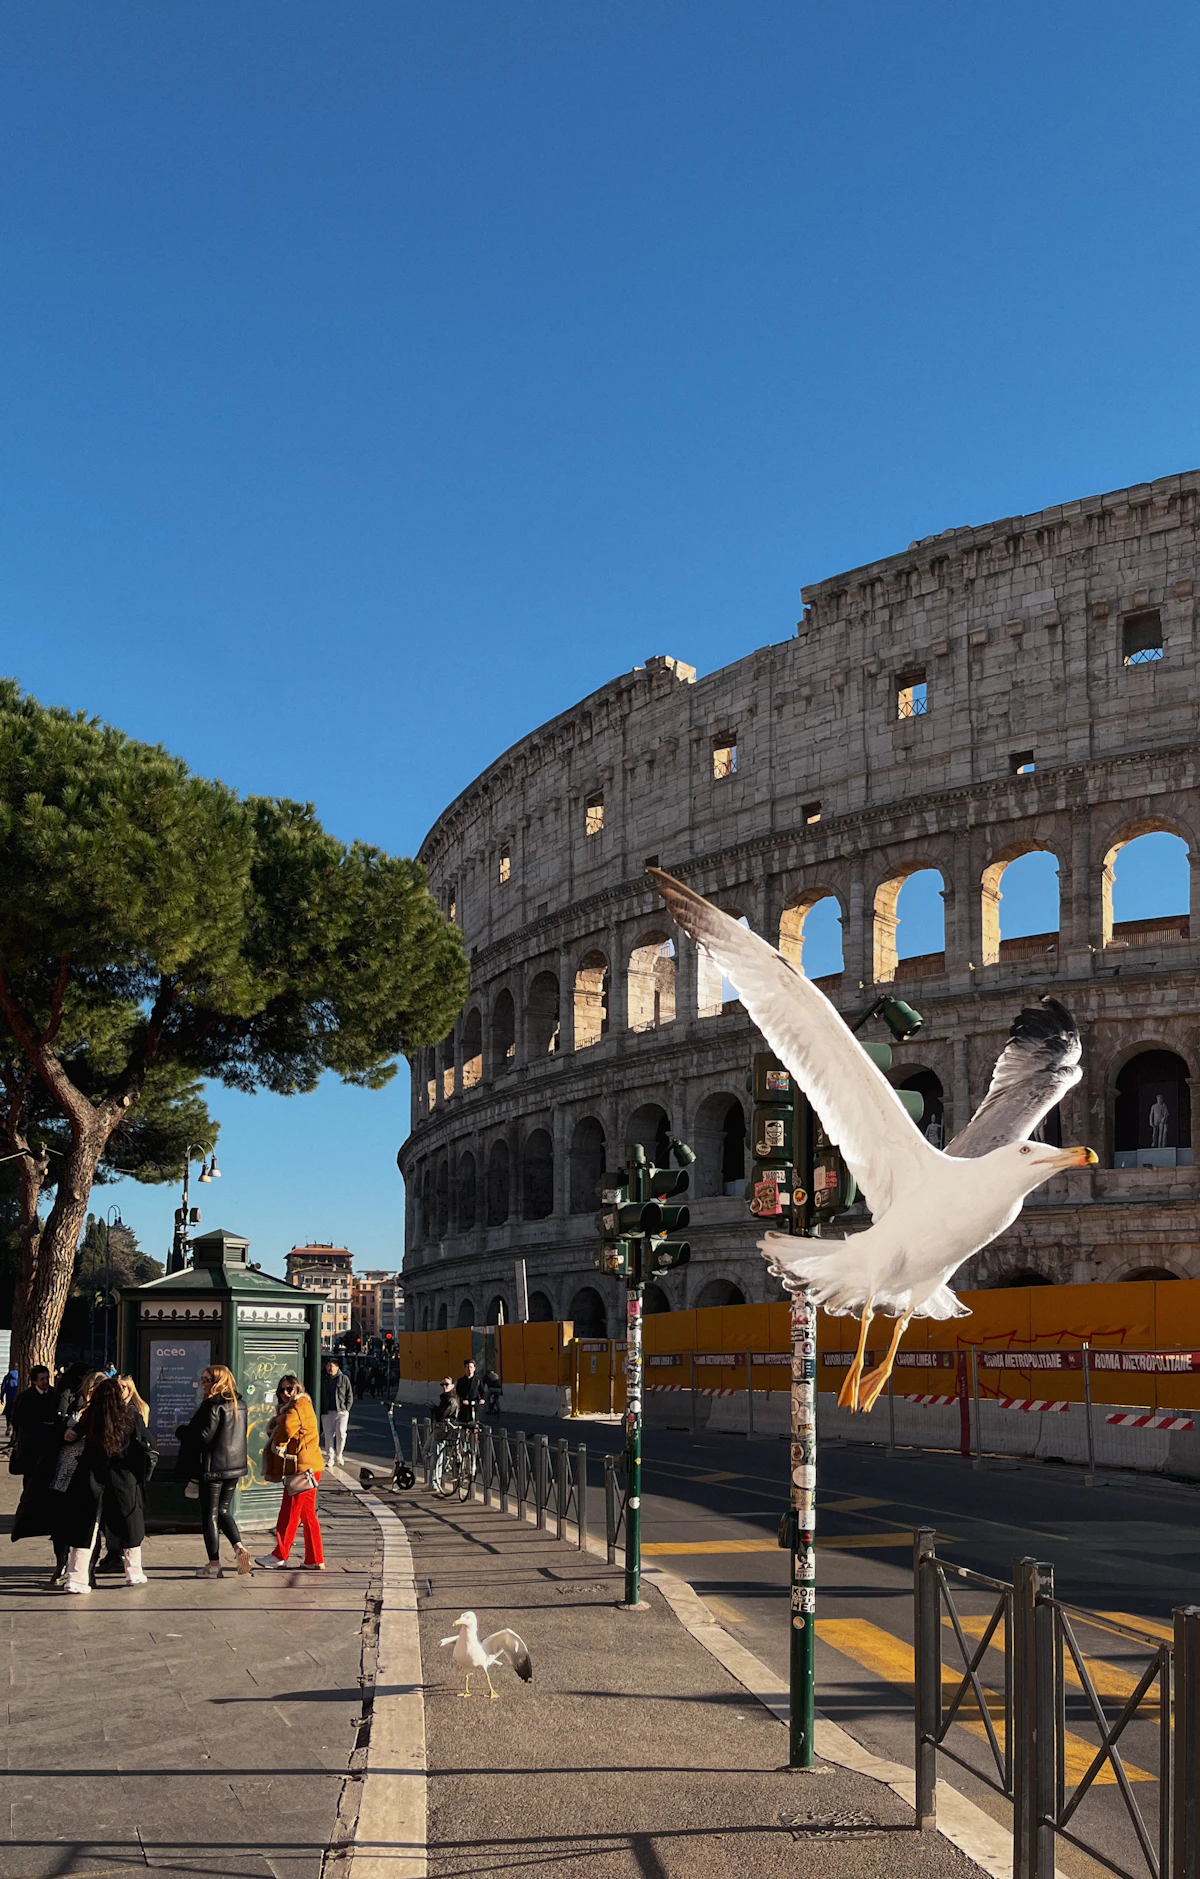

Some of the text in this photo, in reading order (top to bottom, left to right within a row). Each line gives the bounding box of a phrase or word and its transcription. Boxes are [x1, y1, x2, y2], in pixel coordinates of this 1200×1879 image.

[156, 1348, 186, 1357] acea
[897, 1354, 937, 1367] LAVORI LINEA C
[983, 1354, 1004, 1368] ROMA
[1005, 1354, 1062, 1368] METROPOLITANE
[1094, 1354, 1193, 1371] ROMA METROPOLITANE
